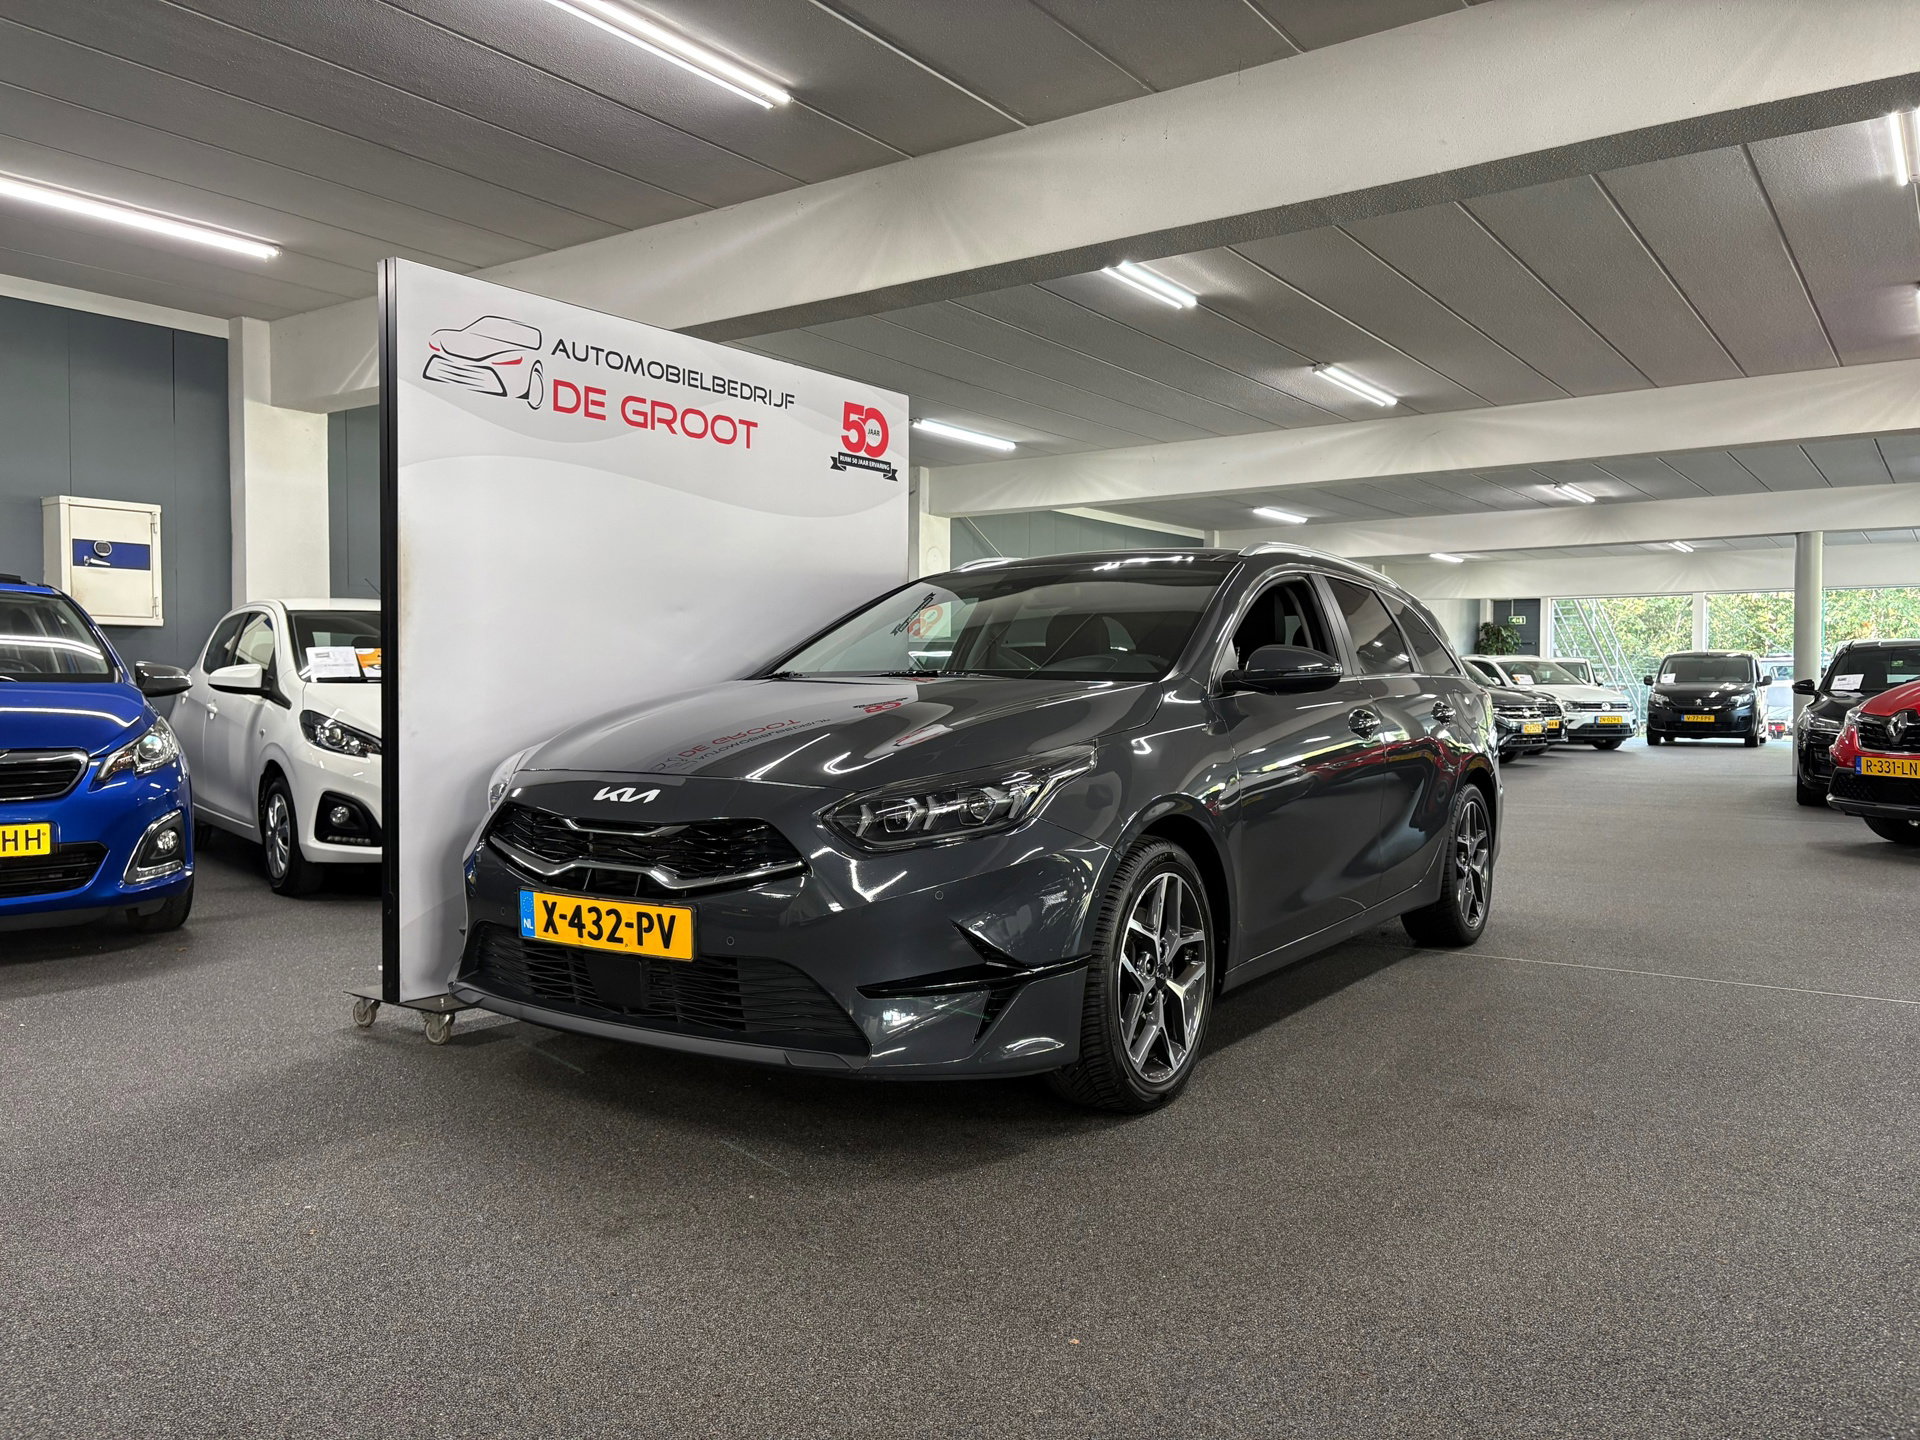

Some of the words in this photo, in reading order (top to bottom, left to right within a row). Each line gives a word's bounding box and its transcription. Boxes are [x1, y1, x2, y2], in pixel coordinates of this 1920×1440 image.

[550, 338, 796, 410] AUTOMOBIELBEDRIJF
[552, 378, 607, 421] DE
[620, 395, 759, 449] GROOT
[841, 401, 890, 458] 50
[867, 428, 880, 436] JAAR
[858, 458, 869, 466] JAAR
[1866, 759, 1918, 776] R-331-LN
[592, 786, 662, 804] KIA
[523, 918, 534, 930] NL
[541, 899, 677, 950] X-432-PV
